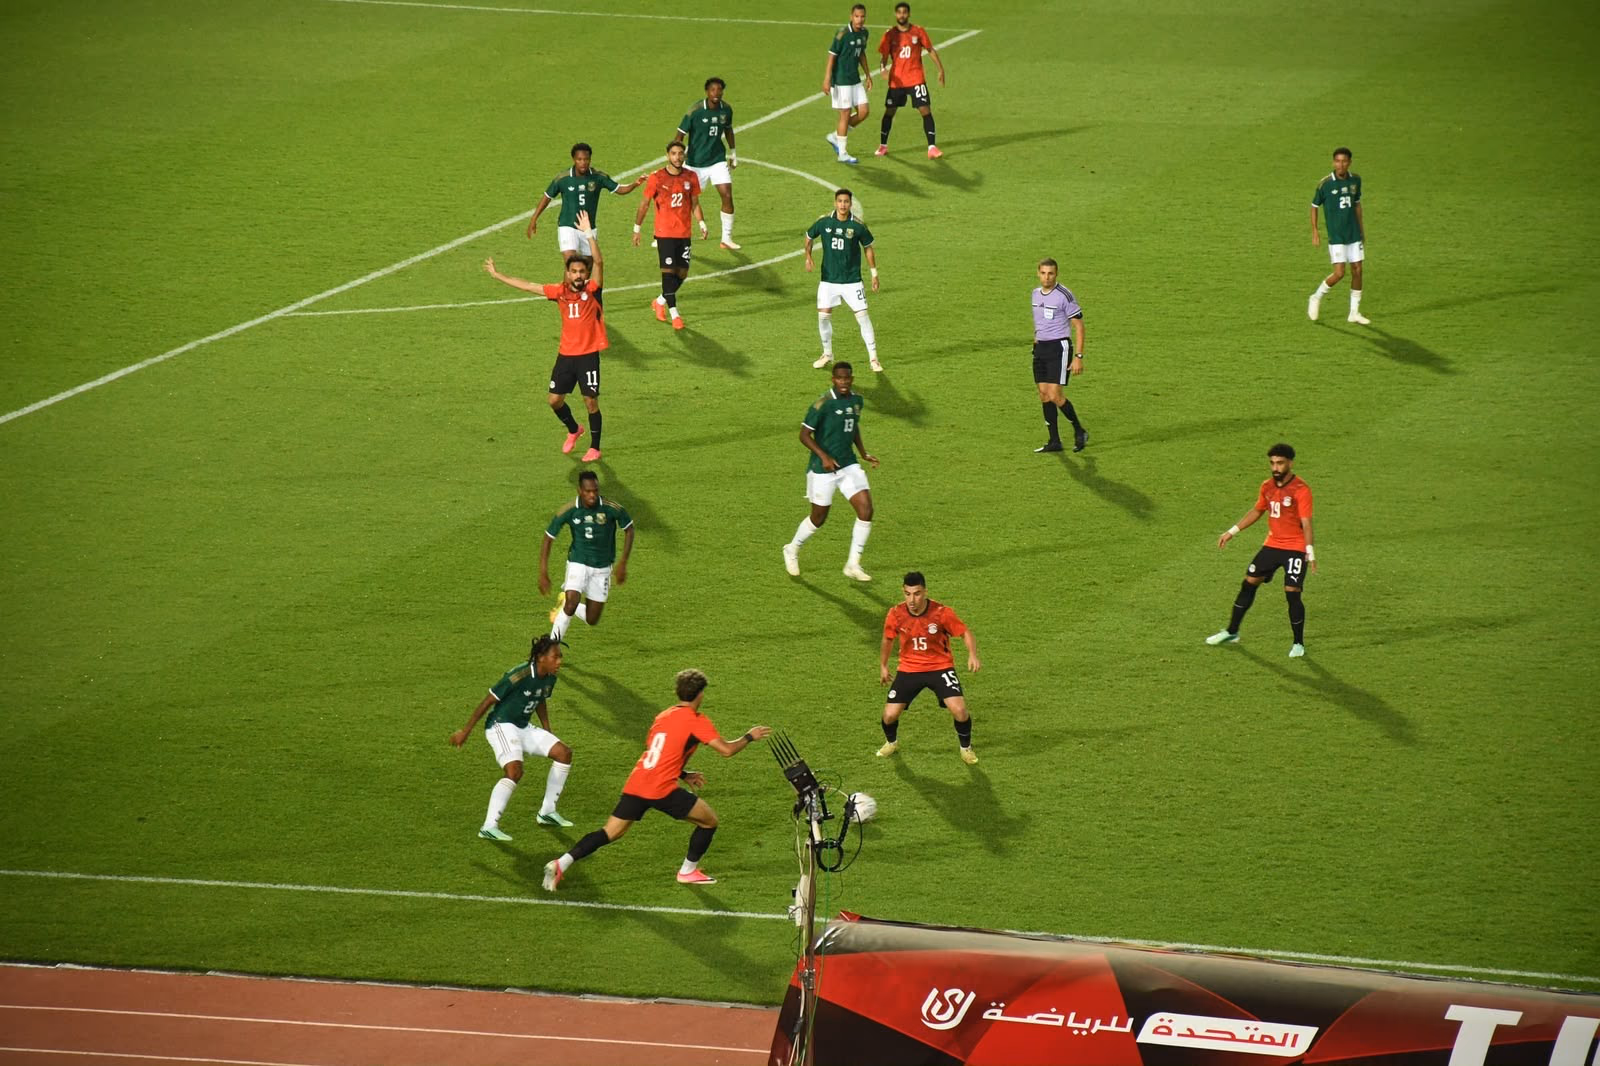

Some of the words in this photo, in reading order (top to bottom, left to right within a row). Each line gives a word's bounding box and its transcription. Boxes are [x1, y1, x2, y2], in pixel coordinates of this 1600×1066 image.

[899, 46, 911, 59] 20
[914, 84, 927, 98] 20
[709, 126, 718, 136] 21
[578, 194, 585, 206] 5
[671, 193, 683, 208] 22
[831, 238, 844, 250] 20
[682, 245, 690, 259] 2
[568, 303, 580, 319] 11
[585, 370, 599, 386] 11
[844, 418, 854, 432] 13
[1269, 500, 1281, 519] 19
[585, 527, 593, 539] 2
[1287, 557, 1302, 575] 19
[911, 636, 928, 651] 15
[941, 670, 959, 687] 15
[982, 1001, 1135, 1036] للرياضة
[1152, 1017, 1300, 1048] المتحدة
